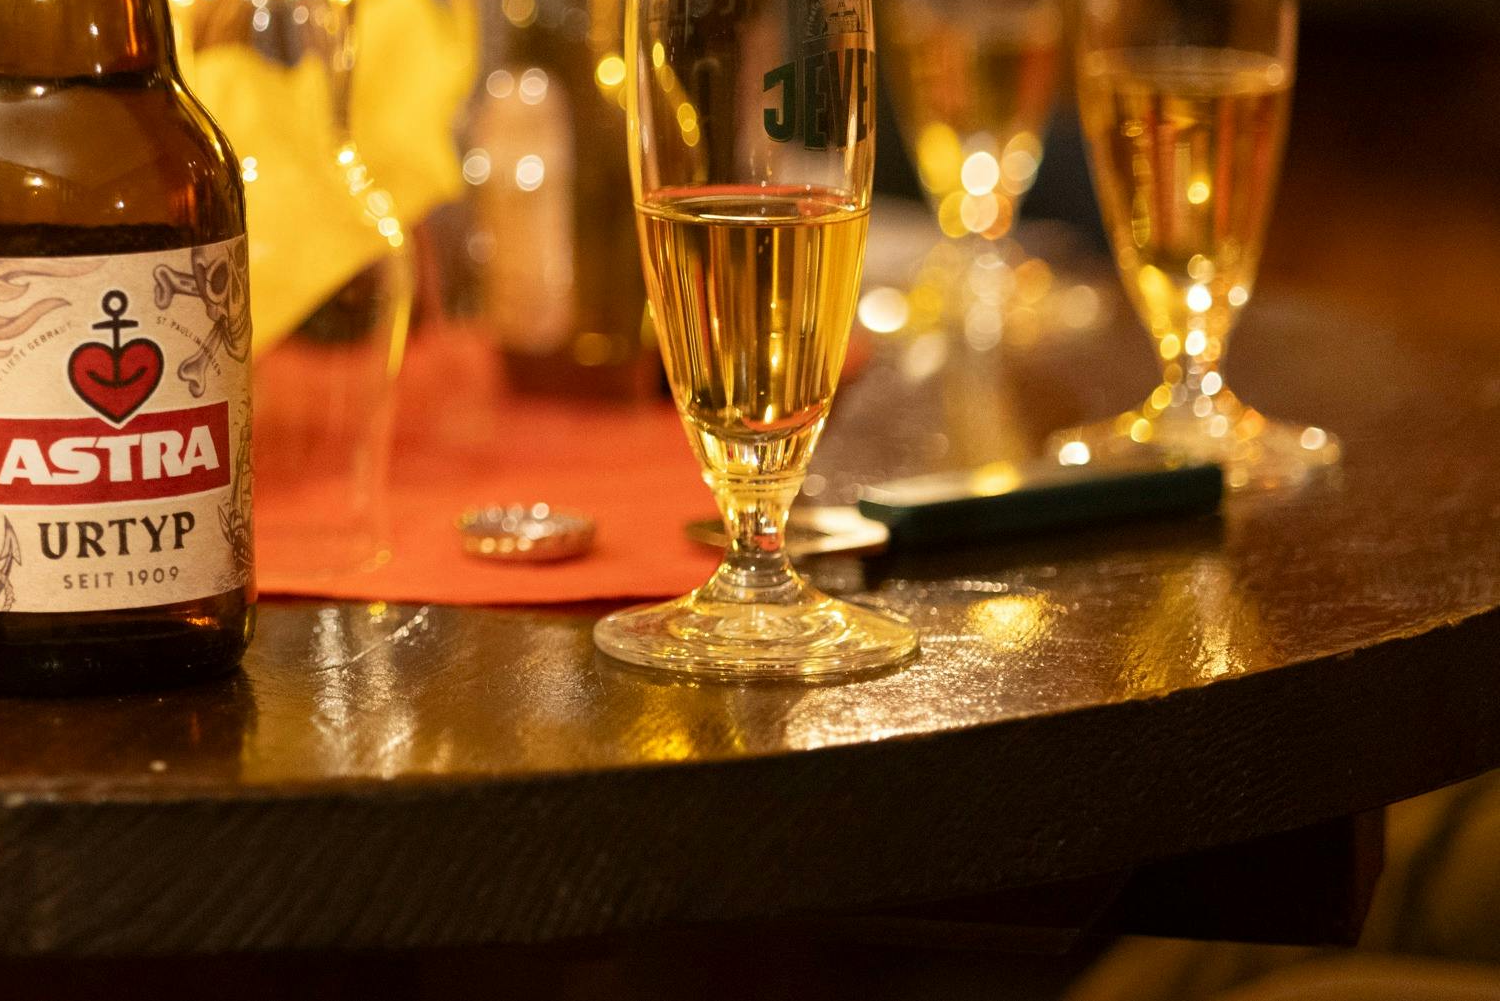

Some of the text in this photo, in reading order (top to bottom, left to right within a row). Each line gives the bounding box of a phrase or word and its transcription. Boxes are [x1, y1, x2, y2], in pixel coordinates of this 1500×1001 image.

[763, 47, 873, 150] JEVE
[37, 511, 196, 560] URTYP
[63, 566, 179, 590] SEIT 1909
